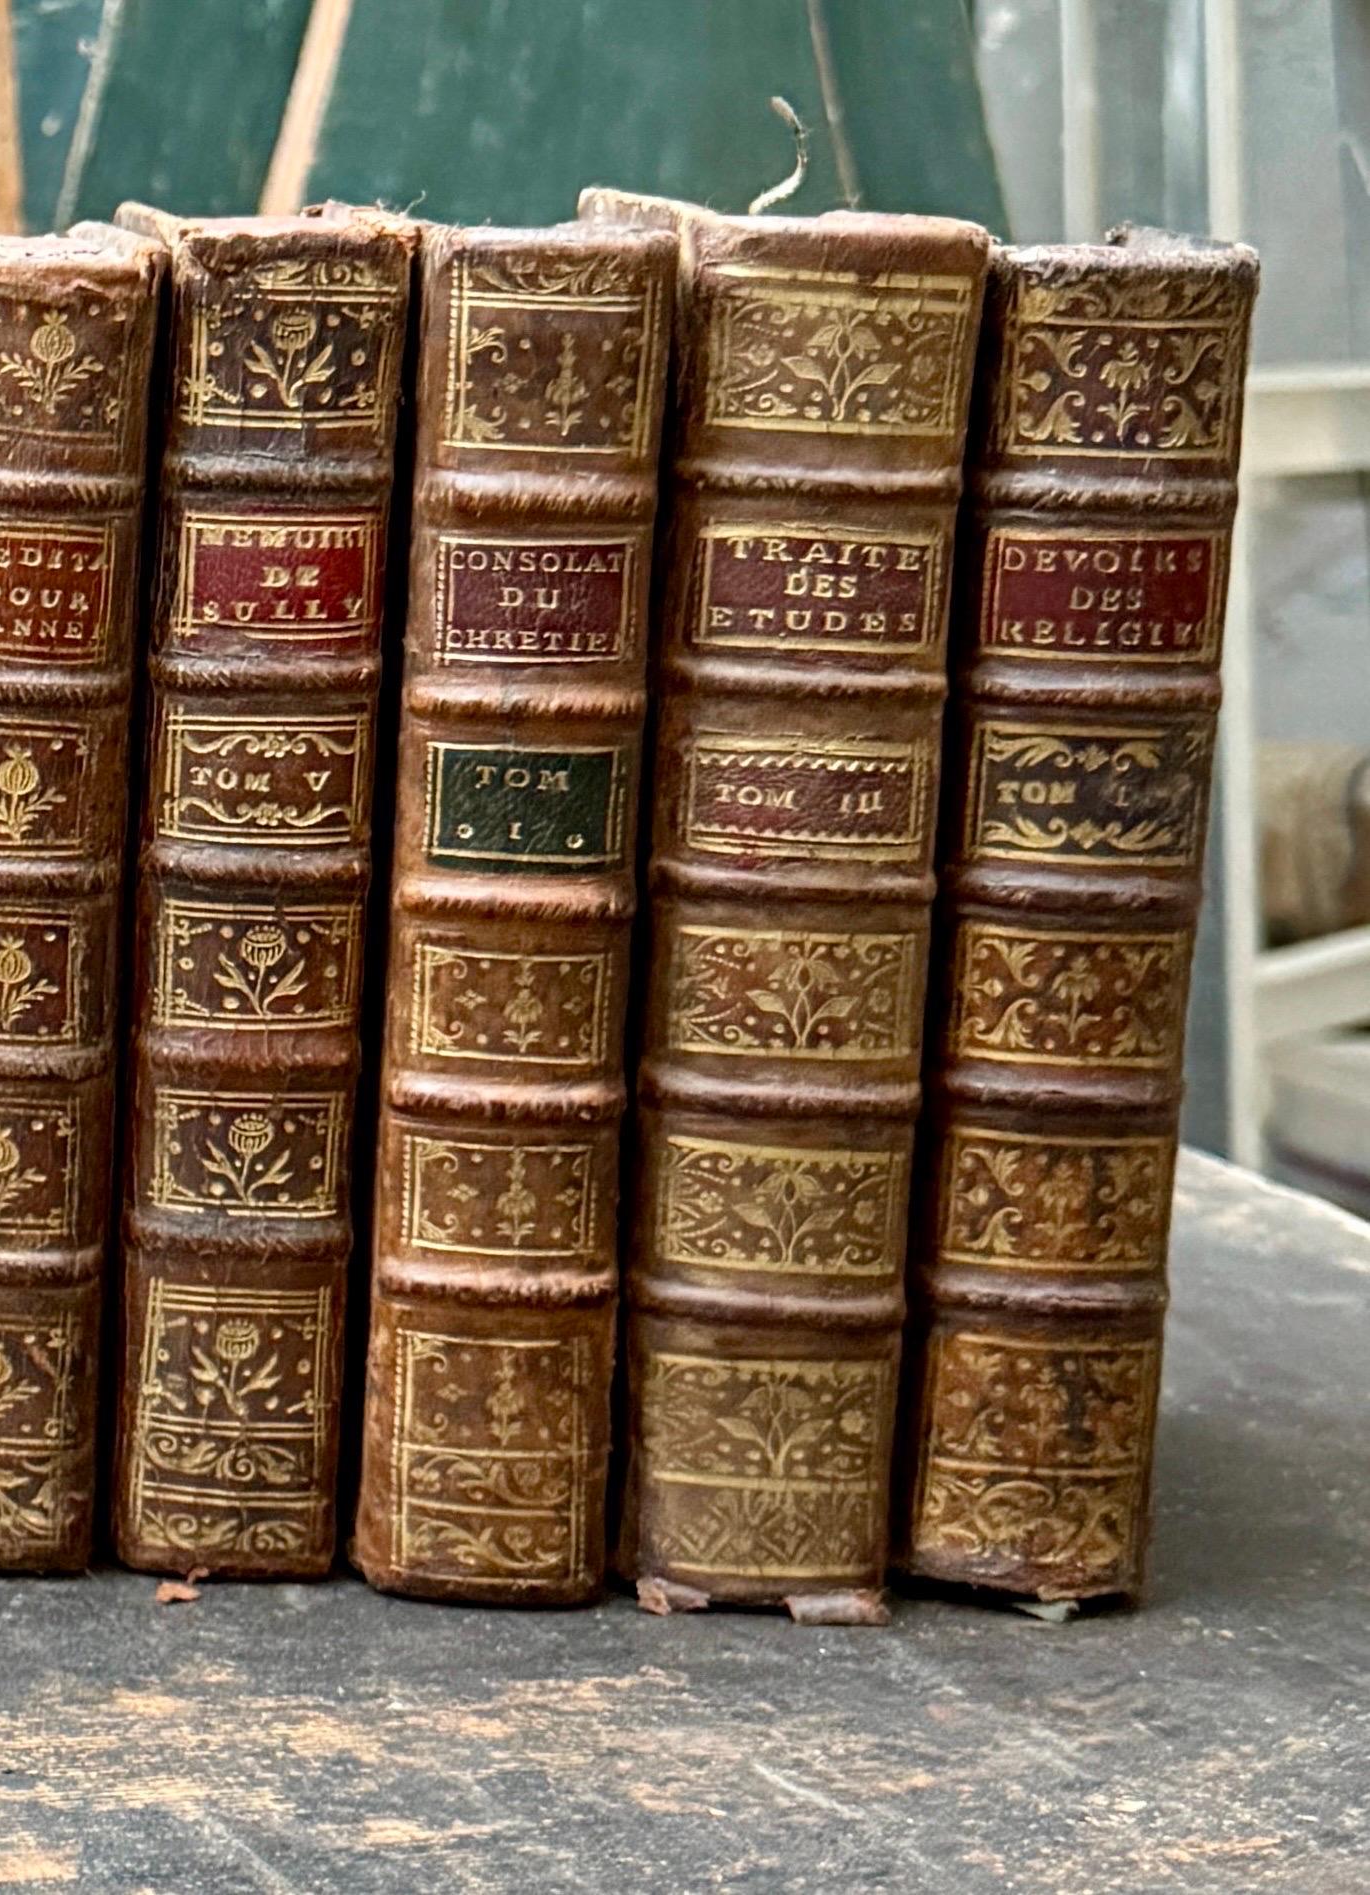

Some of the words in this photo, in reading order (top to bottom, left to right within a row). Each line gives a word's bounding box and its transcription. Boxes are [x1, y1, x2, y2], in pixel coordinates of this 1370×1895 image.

[449, 550, 624, 573] CONSOLAT
[259, 566, 321, 588] DE
[783, 572, 858, 598] DES
[202, 597, 363, 623] SULLY
[499, 587, 561, 609] DU
[1069, 585, 1144, 612] DES
[710, 606, 916, 632] ETUDES
[189, 767, 271, 792] TOM
[303, 771, 332, 791] V
[475, 765, 570, 791] TOM
[715, 784, 800, 811] TOM
[840, 790, 884, 815] III
[996, 780, 1078, 804] TOM
[509, 822, 523, 840] I
